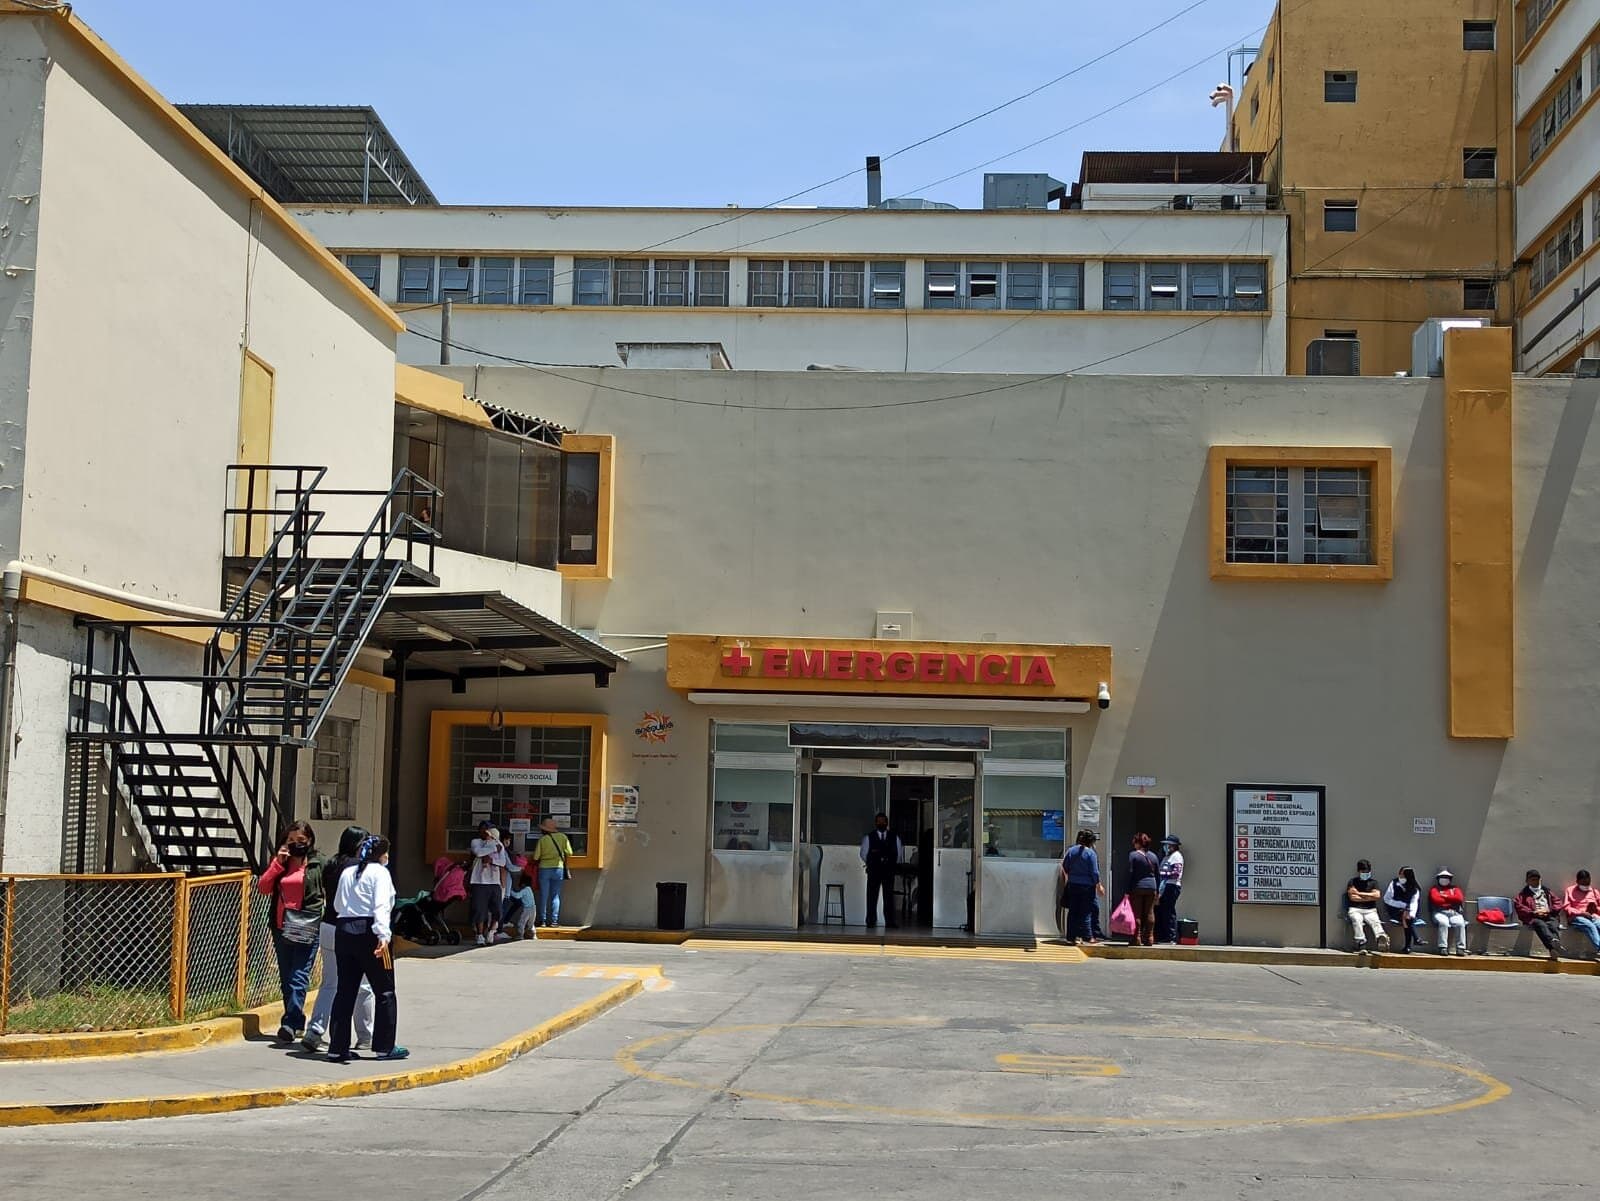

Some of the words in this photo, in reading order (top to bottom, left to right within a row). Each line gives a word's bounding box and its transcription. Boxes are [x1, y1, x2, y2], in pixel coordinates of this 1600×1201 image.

[763, 648, 1056, 686] EMERGENCIA
[498, 772, 528, 780] SERVICIO
[529, 773, 552, 781] SOCIAL
[1253, 839, 1289, 849] EMERGENCIA
[1290, 839, 1316, 850] ADULTOS
[1253, 851, 1285, 861] EMERGENCIA
[1253, 865, 1288, 875] SERVICIO
[1289, 866, 1316, 876] SOCIAL
[1253, 877, 1282, 887] FARMACIA
